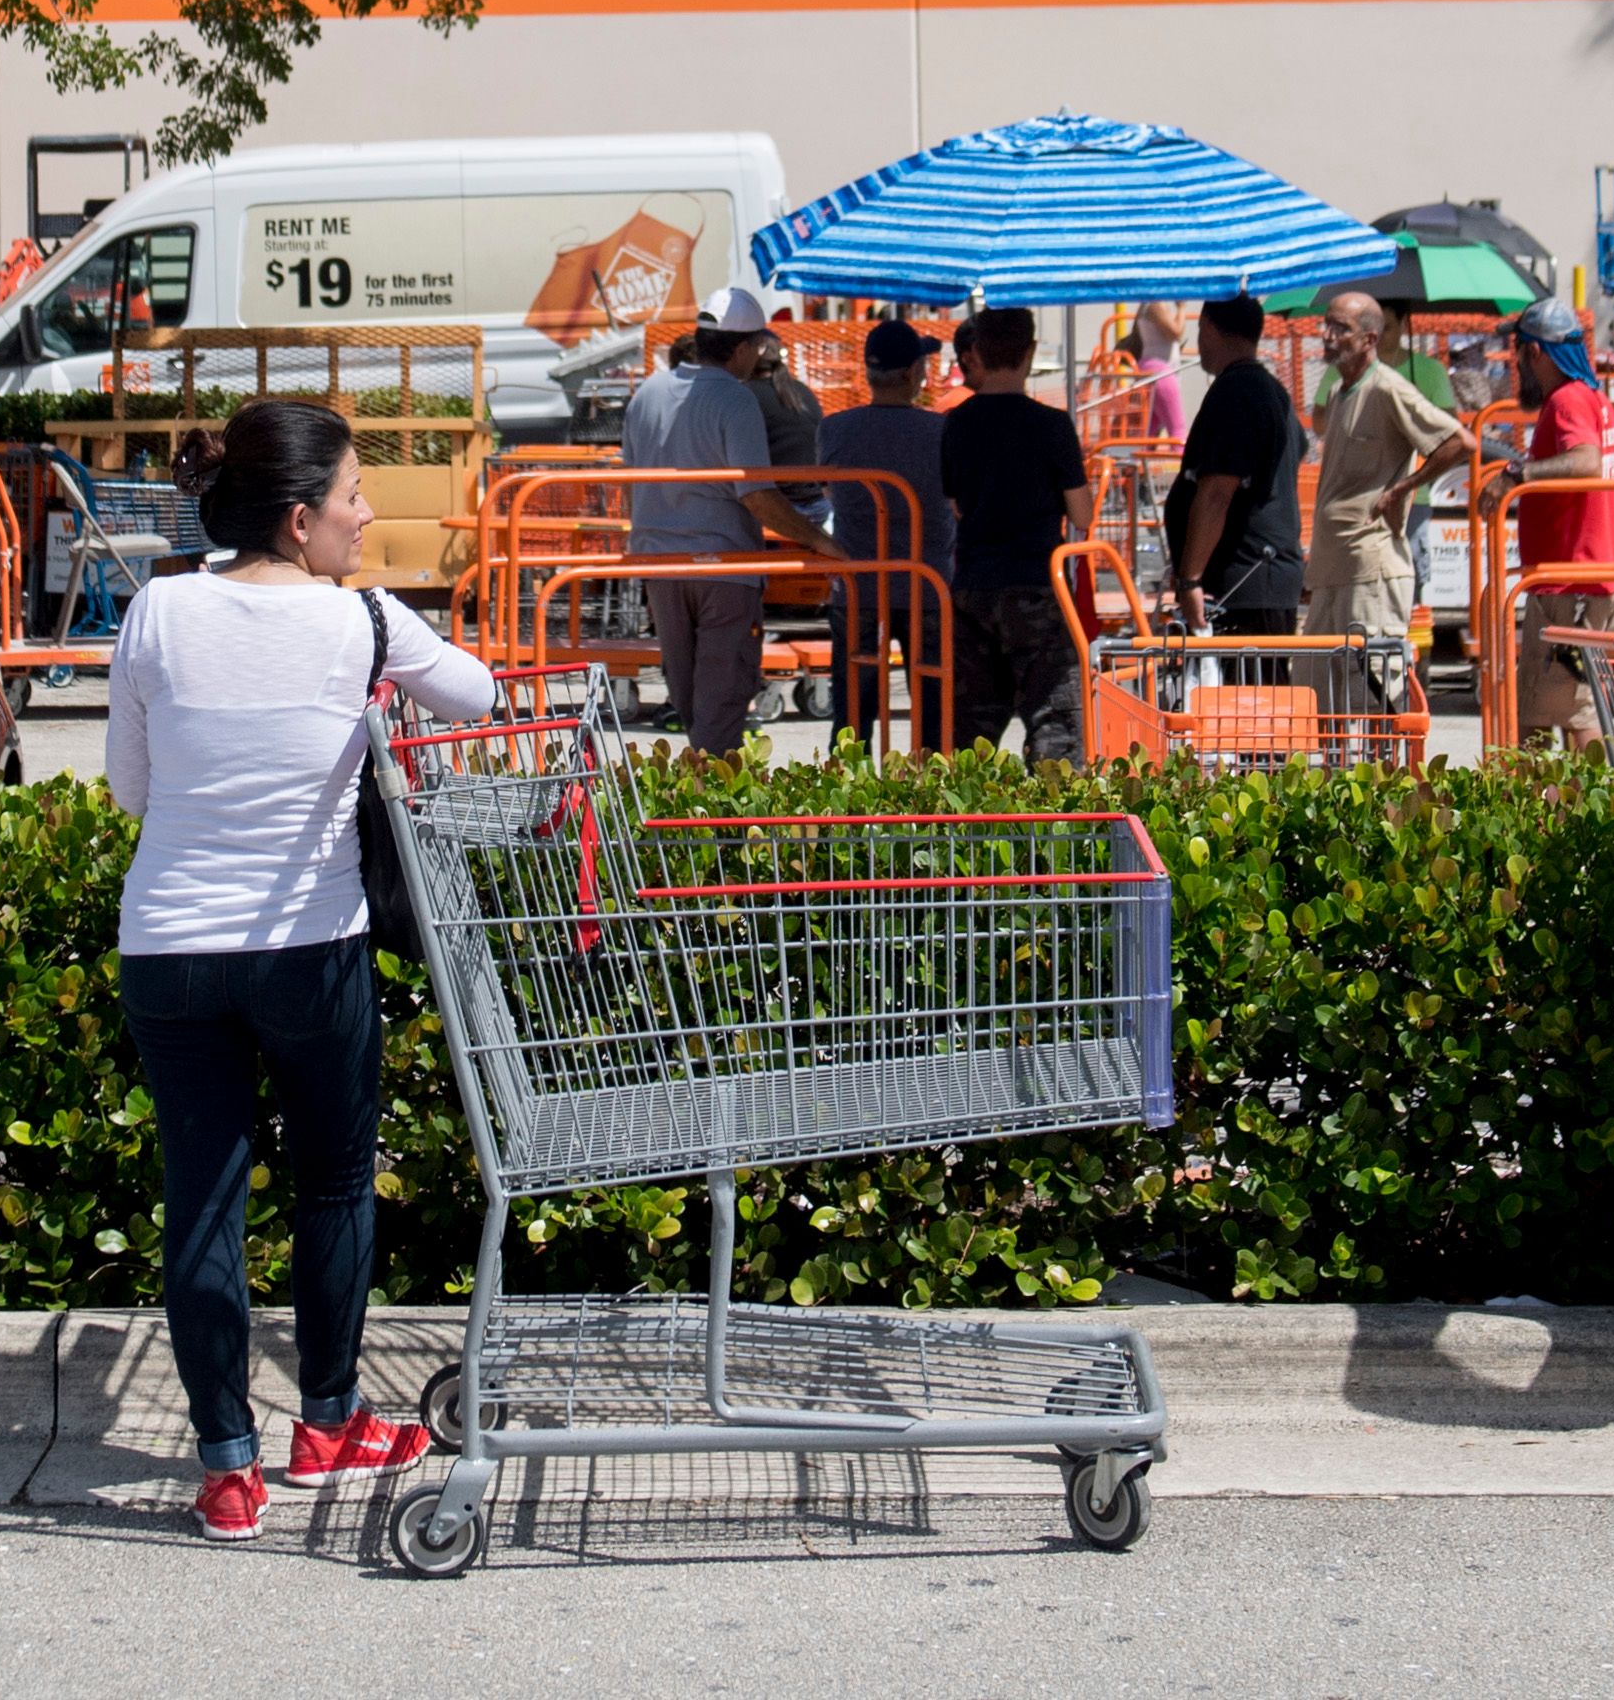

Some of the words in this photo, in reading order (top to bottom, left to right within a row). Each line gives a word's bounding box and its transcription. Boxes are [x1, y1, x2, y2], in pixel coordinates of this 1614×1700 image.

[264, 218, 313, 237] RENT
[321, 217, 351, 235] ME
[264, 239, 311, 253] Starting
[265, 256, 352, 309] $19
[365, 275, 387, 289] for
[392, 274, 416, 288] the
[421, 273, 454, 287] first
[365, 294, 384, 307] 75
[390, 292, 452, 306] minutes
